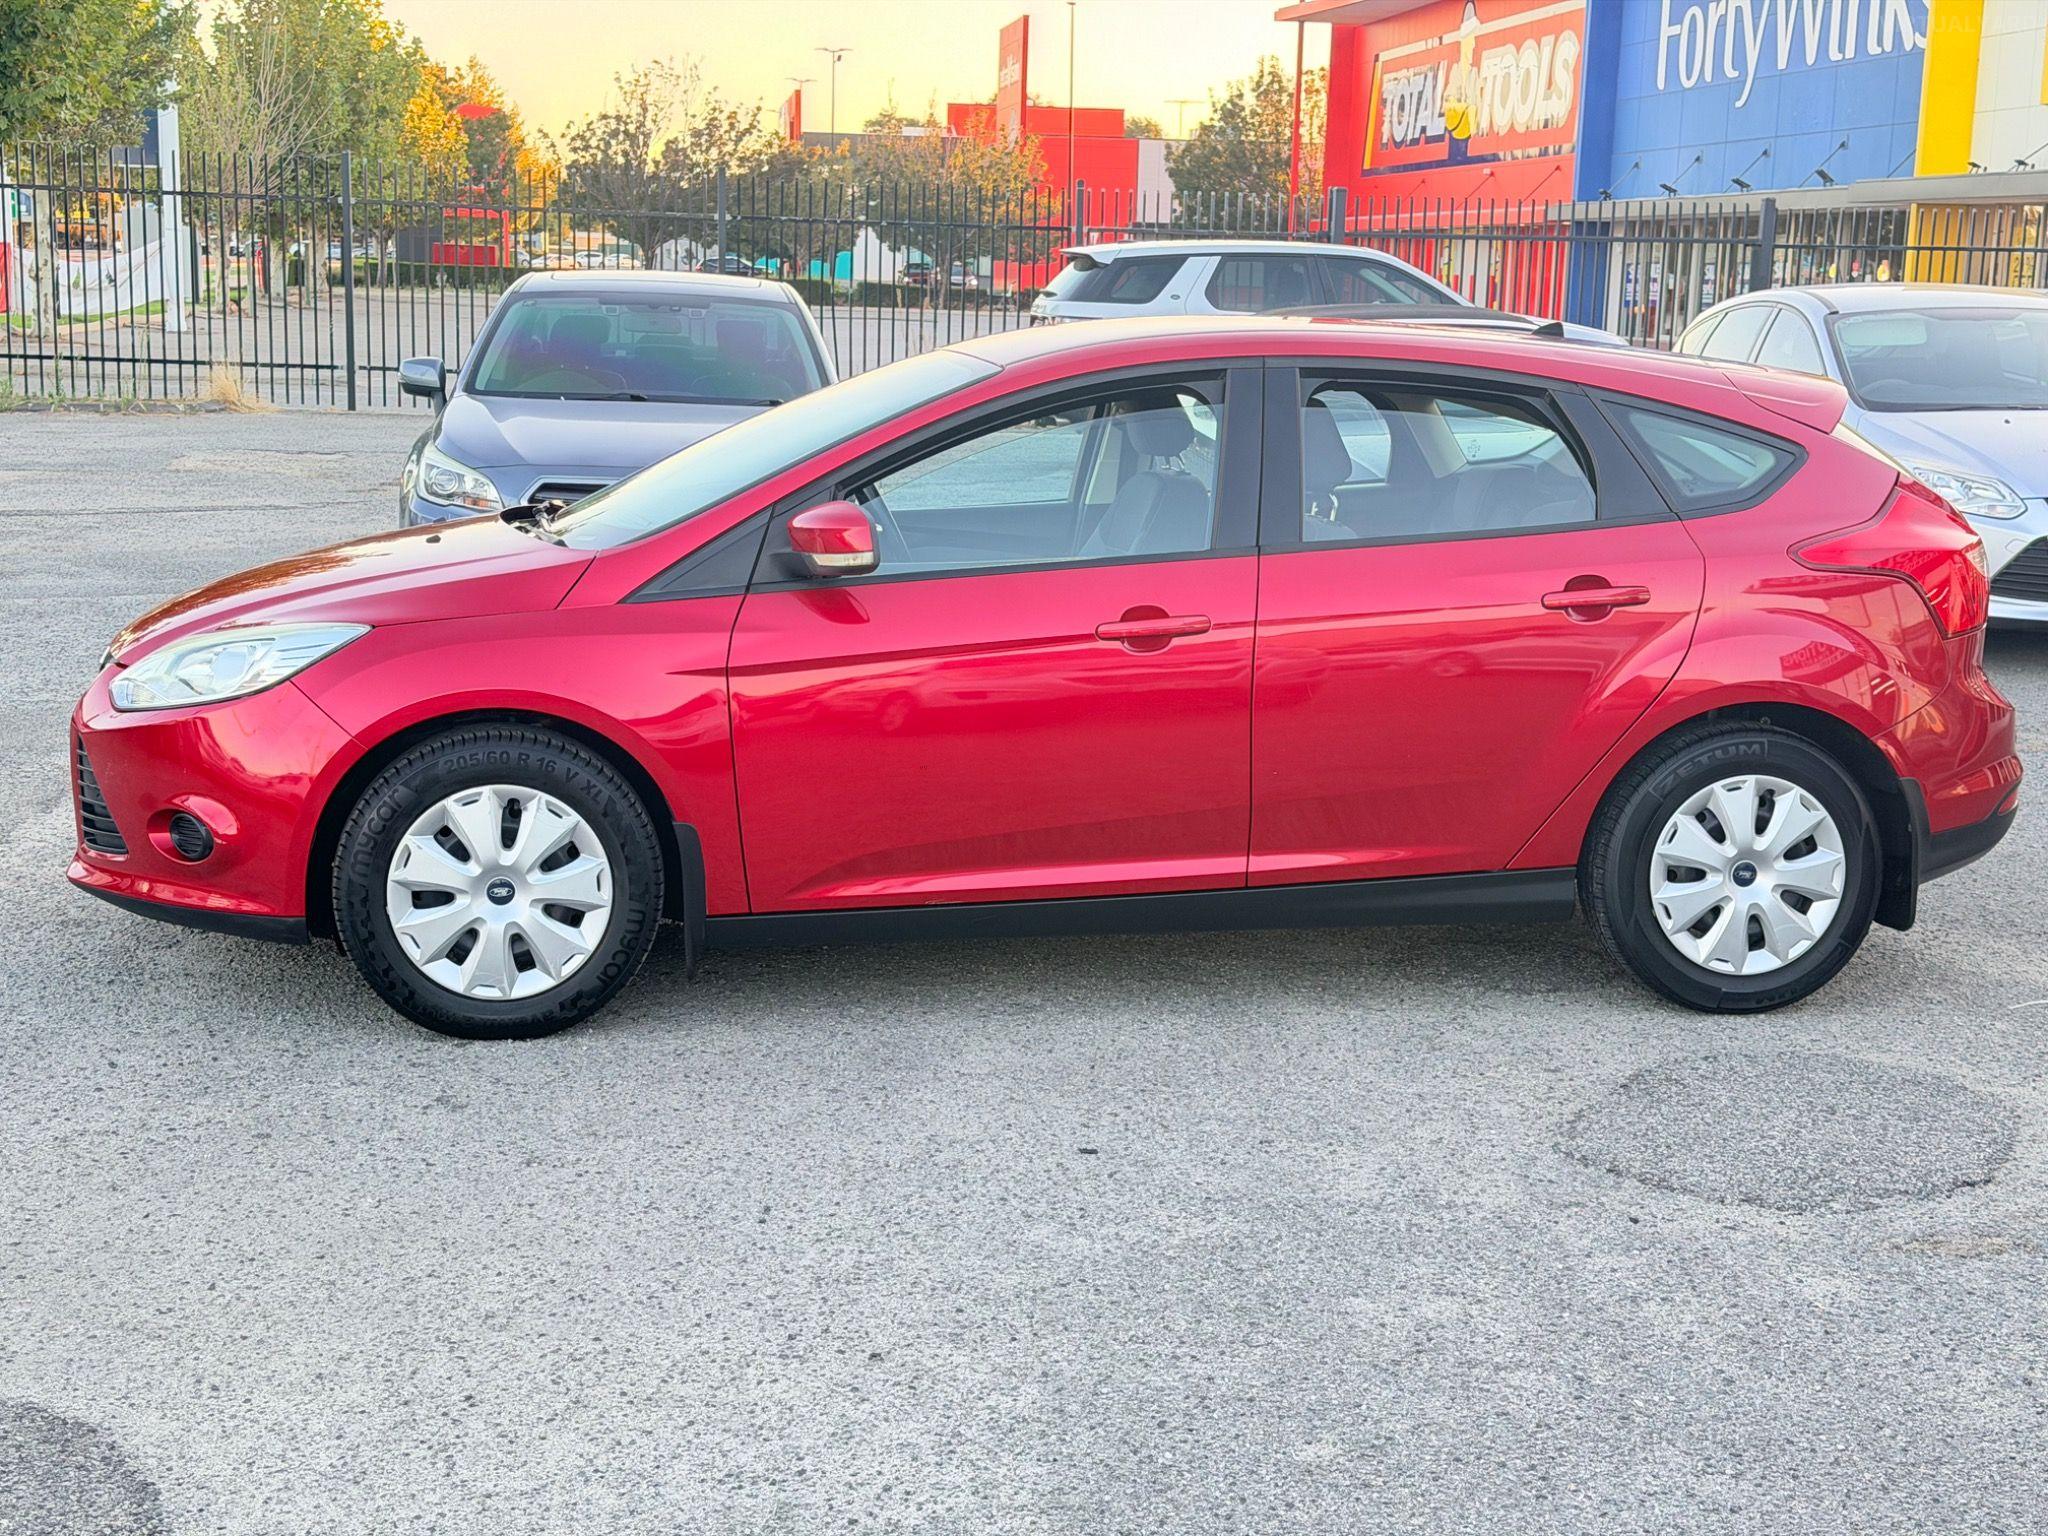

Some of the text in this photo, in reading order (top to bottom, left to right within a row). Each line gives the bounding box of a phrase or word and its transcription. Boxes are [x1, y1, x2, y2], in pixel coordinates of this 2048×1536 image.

[1382, 30, 1580, 148] TOTAL TOOLS
[444, 750, 511, 774] 205/60
[517, 752, 531, 768] R
[536, 758, 558, 774] 16
[564, 767, 580, 783] V
[1660, 743, 1761, 788] ZETUM
